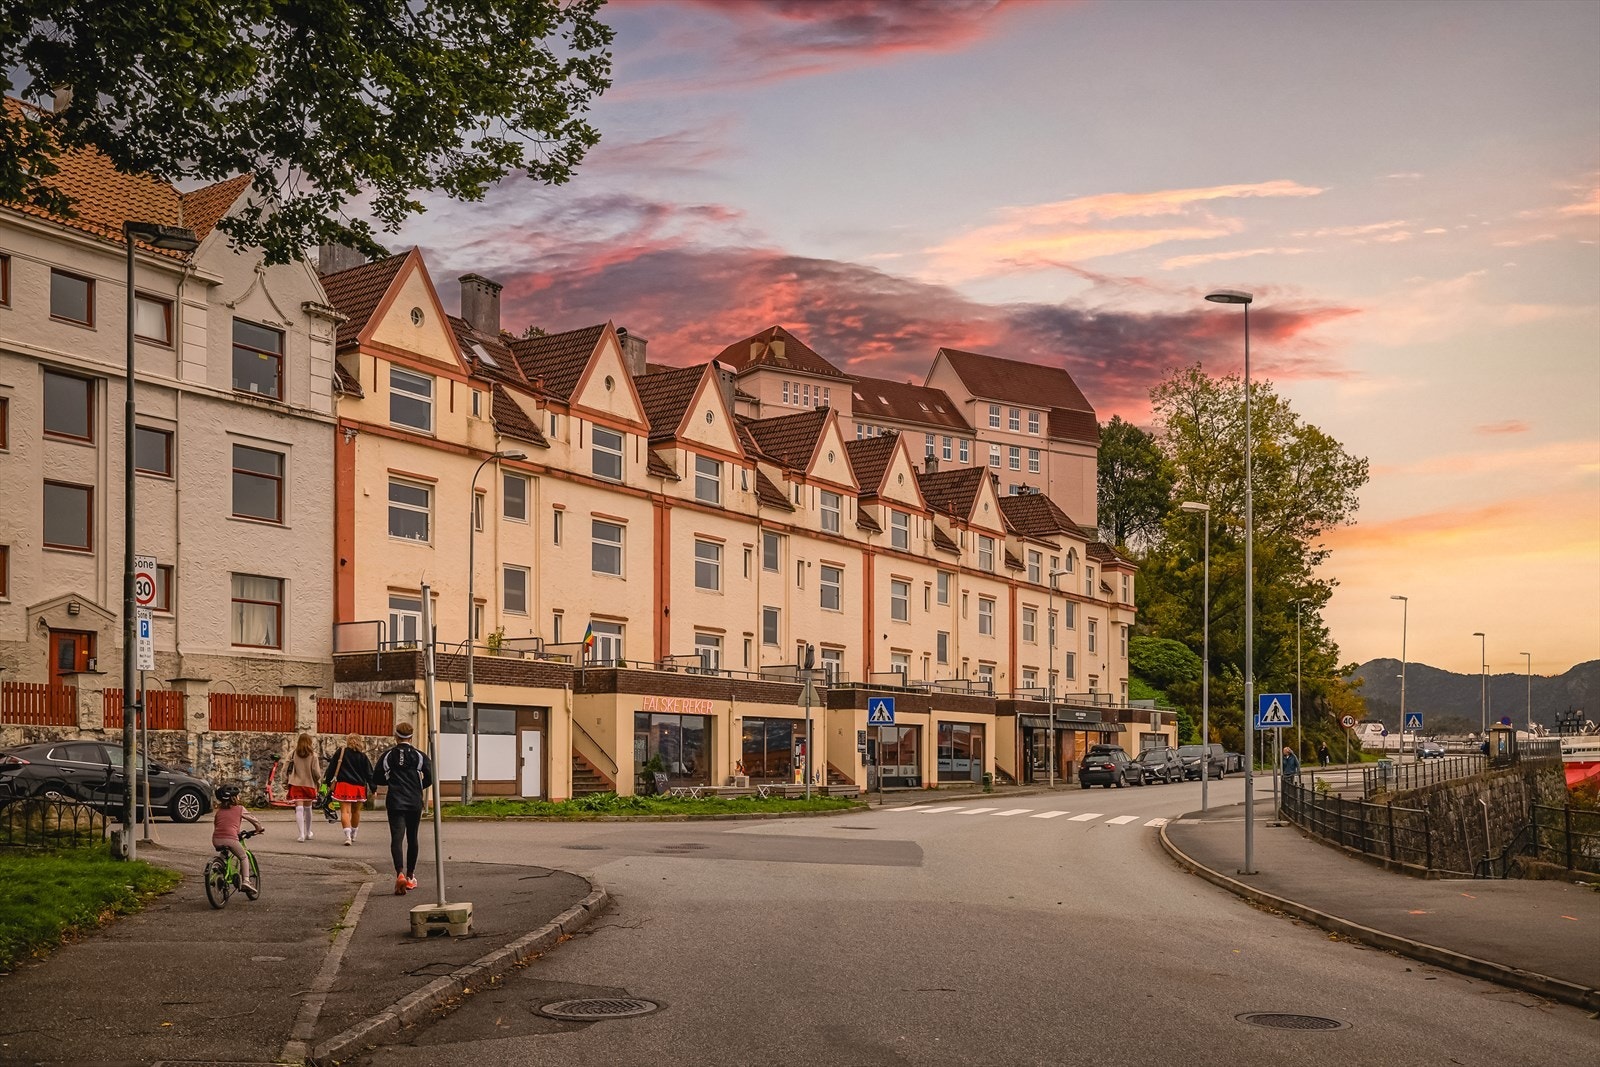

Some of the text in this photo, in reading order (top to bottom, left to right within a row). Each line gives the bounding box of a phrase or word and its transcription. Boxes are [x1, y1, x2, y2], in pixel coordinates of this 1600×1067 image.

[136, 581, 151, 596] 30
[642, 696, 713, 714] FALSKE REKER
[1343, 717, 1353, 725] 40
